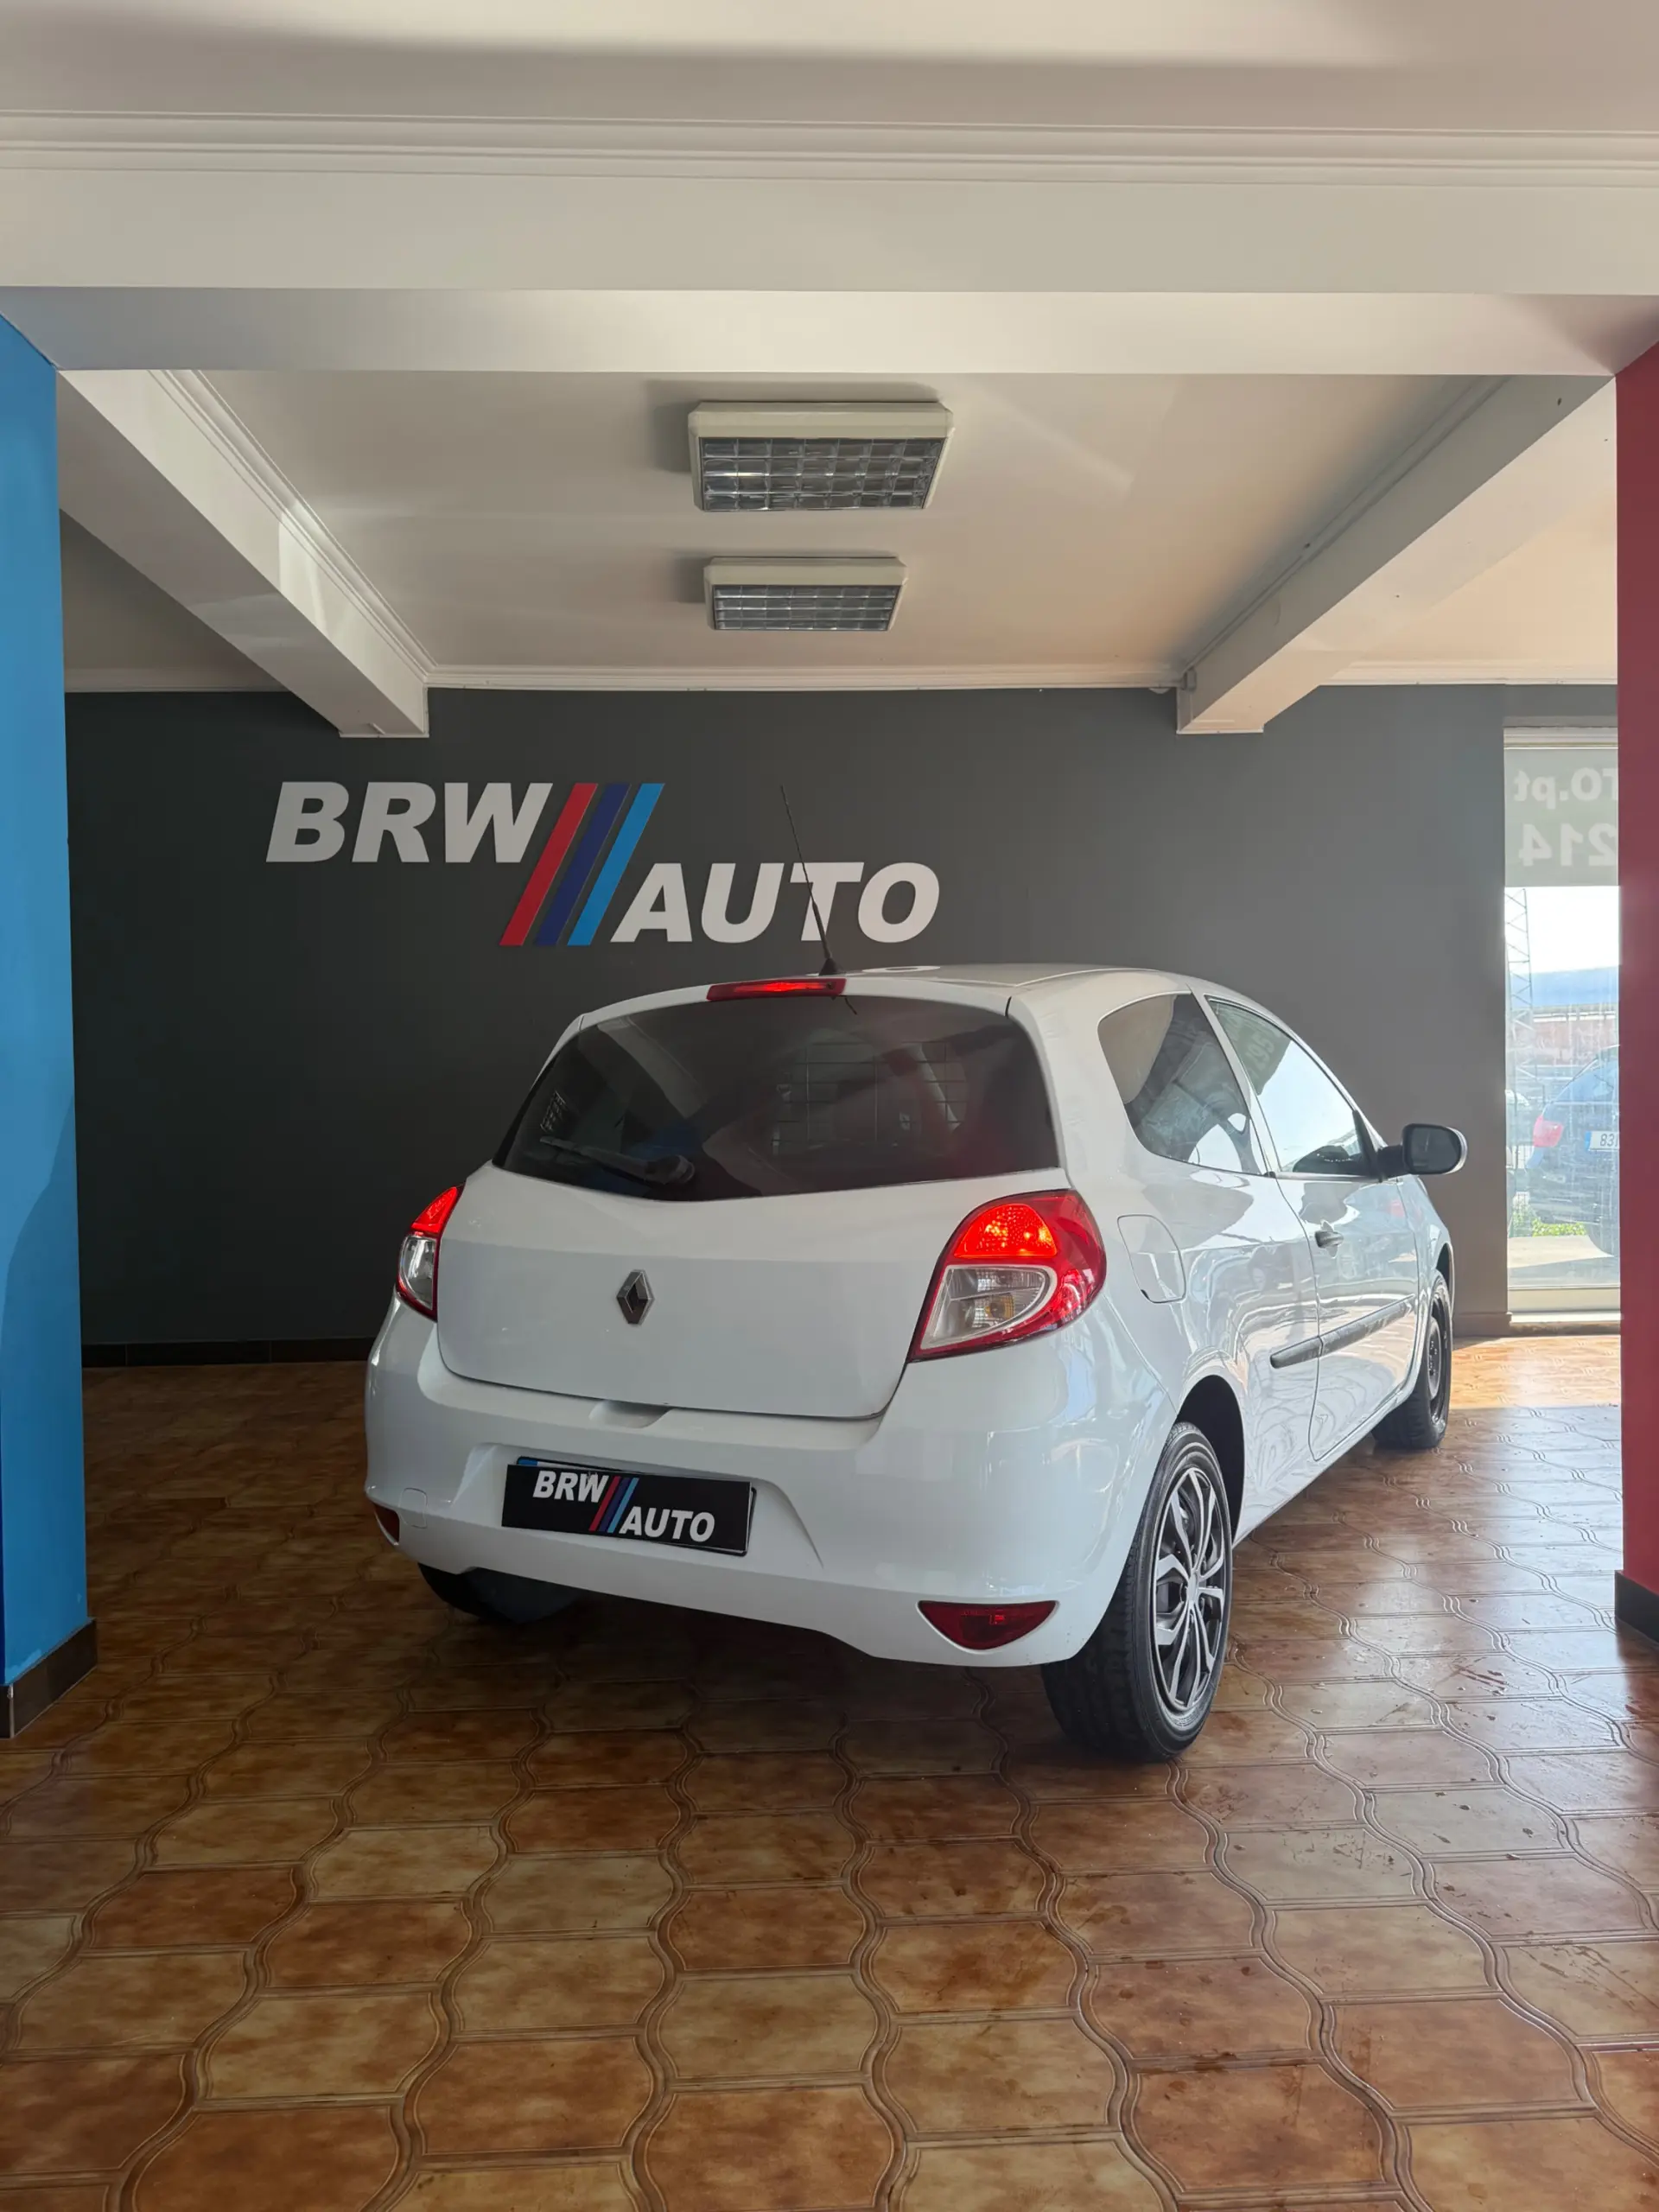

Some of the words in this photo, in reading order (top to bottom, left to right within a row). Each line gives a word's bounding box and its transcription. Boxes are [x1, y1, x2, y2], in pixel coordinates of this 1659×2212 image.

[265, 781, 554, 863] BRW
[610, 862, 940, 944] AUTO
[532, 1471, 610, 1503] BRW
[619, 1506, 715, 1543] AUTO
